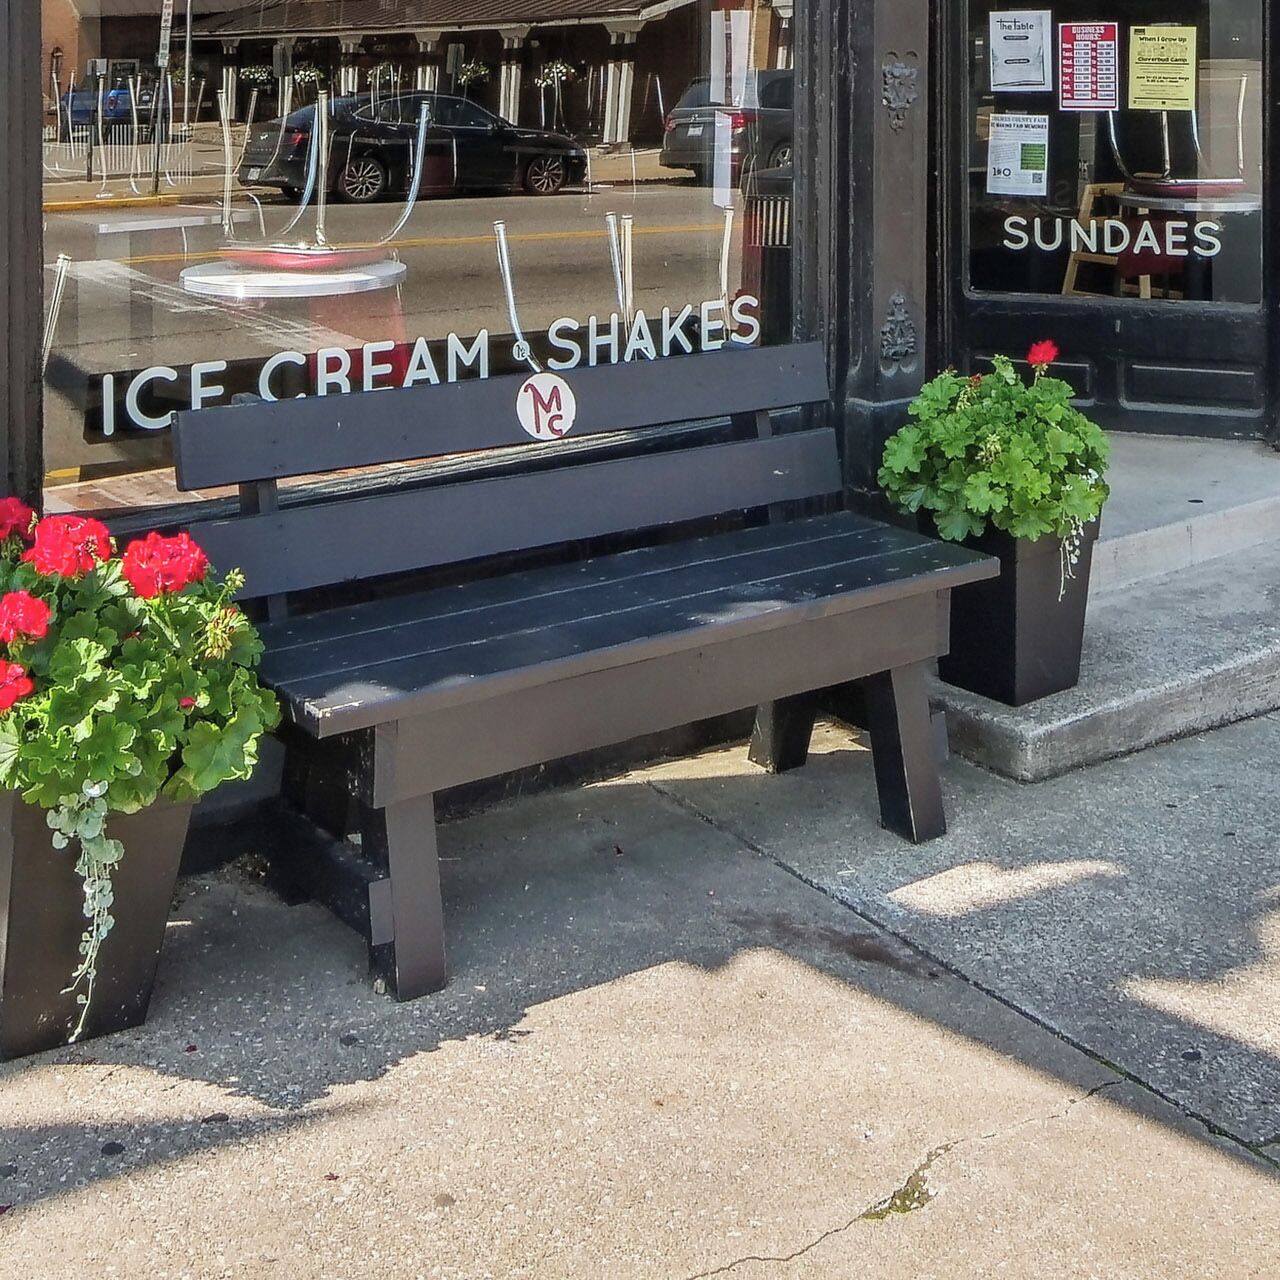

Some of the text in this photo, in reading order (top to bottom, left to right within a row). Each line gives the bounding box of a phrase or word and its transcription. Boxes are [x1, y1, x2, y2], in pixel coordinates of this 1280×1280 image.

[1003, 215, 1222, 257] SUNDAES
[258, 328, 490, 403] CREAM
[546, 294, 761, 371] SHAKES
